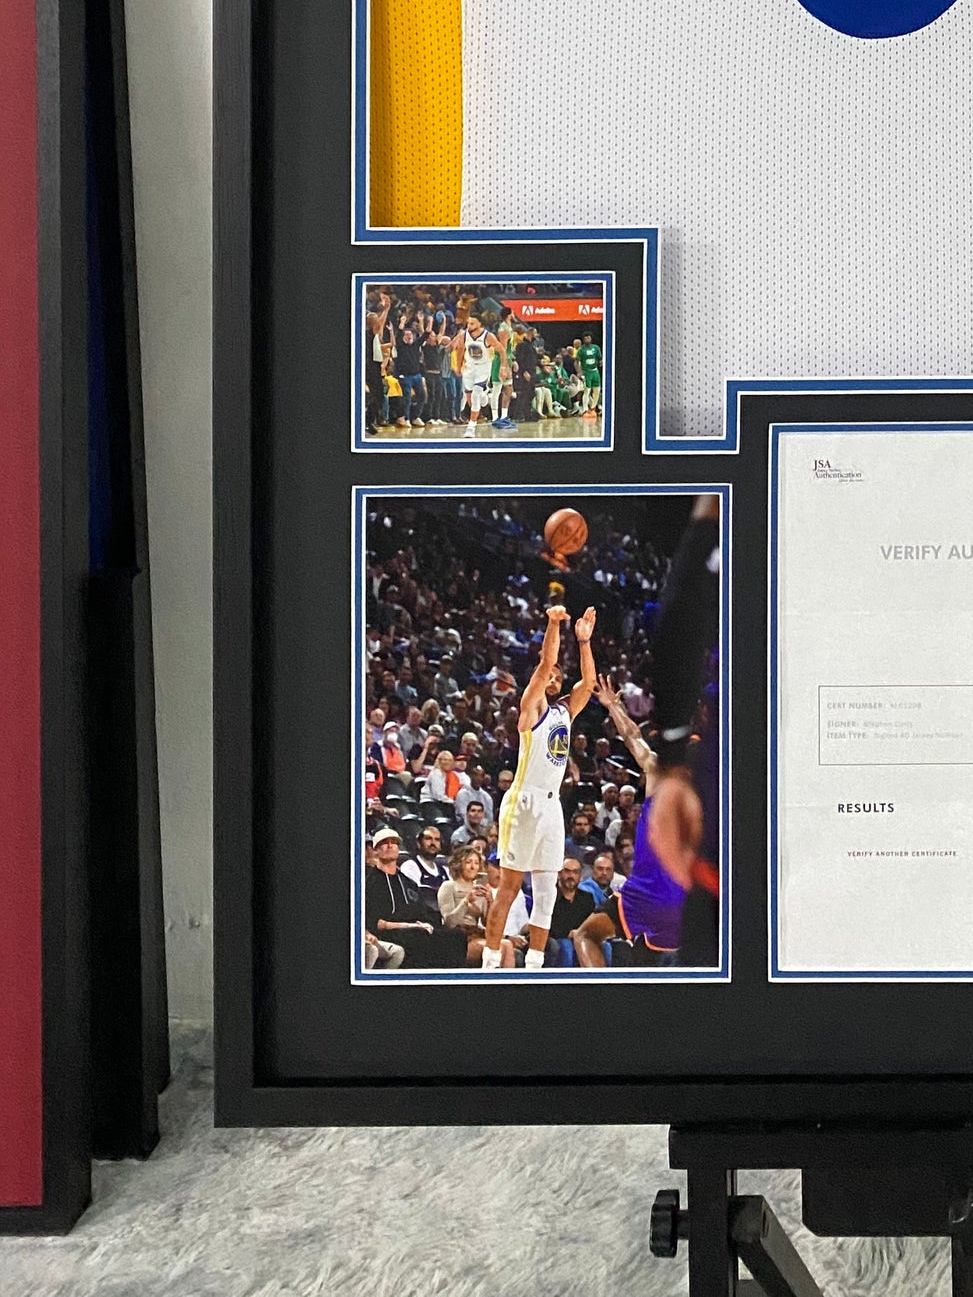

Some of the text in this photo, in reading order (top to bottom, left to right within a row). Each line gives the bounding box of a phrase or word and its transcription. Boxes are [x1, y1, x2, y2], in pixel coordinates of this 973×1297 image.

[812, 460, 831, 471] JSA
[880, 544, 942, 561] VERIFY
[837, 803, 895, 813] RESULTS
